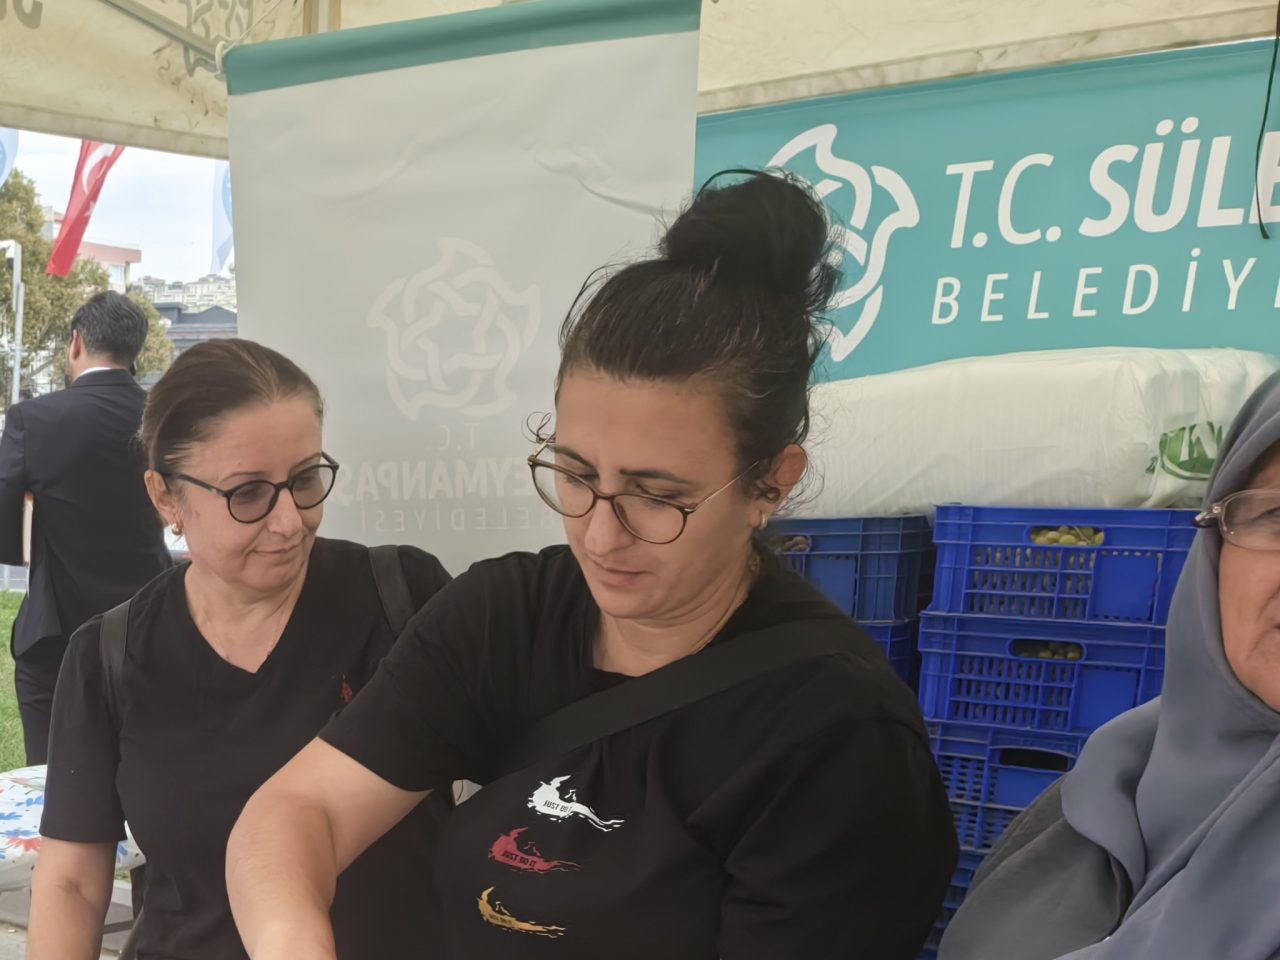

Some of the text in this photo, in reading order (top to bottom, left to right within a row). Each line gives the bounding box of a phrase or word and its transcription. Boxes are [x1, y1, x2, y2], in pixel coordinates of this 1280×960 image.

[946, 153, 1062, 248] T.C.
[931, 248, 1280, 326] BELEDİY
[543, 800, 560, 811] JUST
[501, 850, 518, 861] JUST
